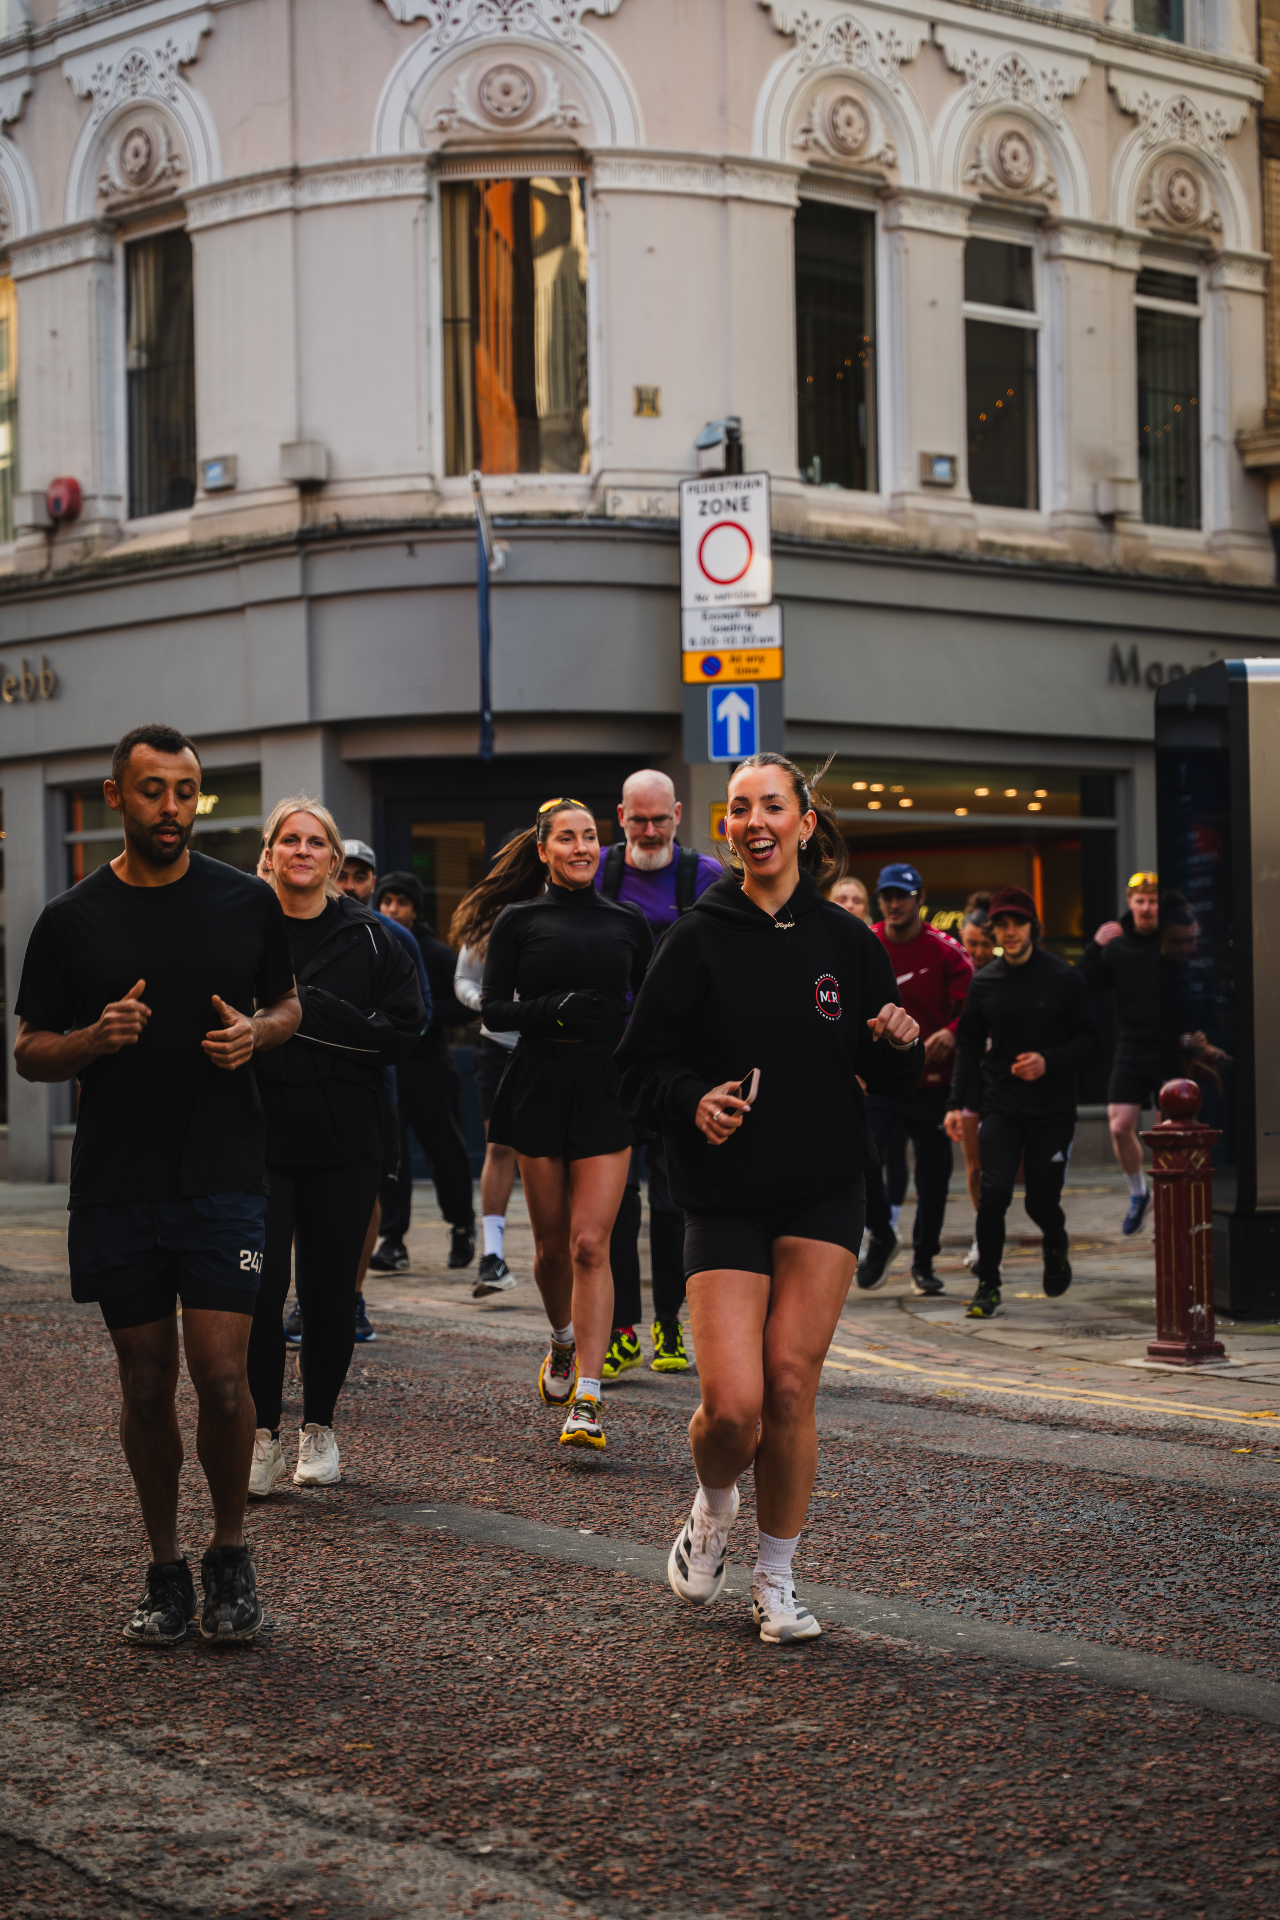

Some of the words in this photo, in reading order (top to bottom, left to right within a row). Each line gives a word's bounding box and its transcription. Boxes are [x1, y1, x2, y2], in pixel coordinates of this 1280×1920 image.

[686, 479, 762, 495] PEDESTRIAN
[698, 496, 750, 516] ZONE
[701, 610, 741, 622] Except
[745, 609, 760, 620] for
[710, 622, 752, 634] loading
